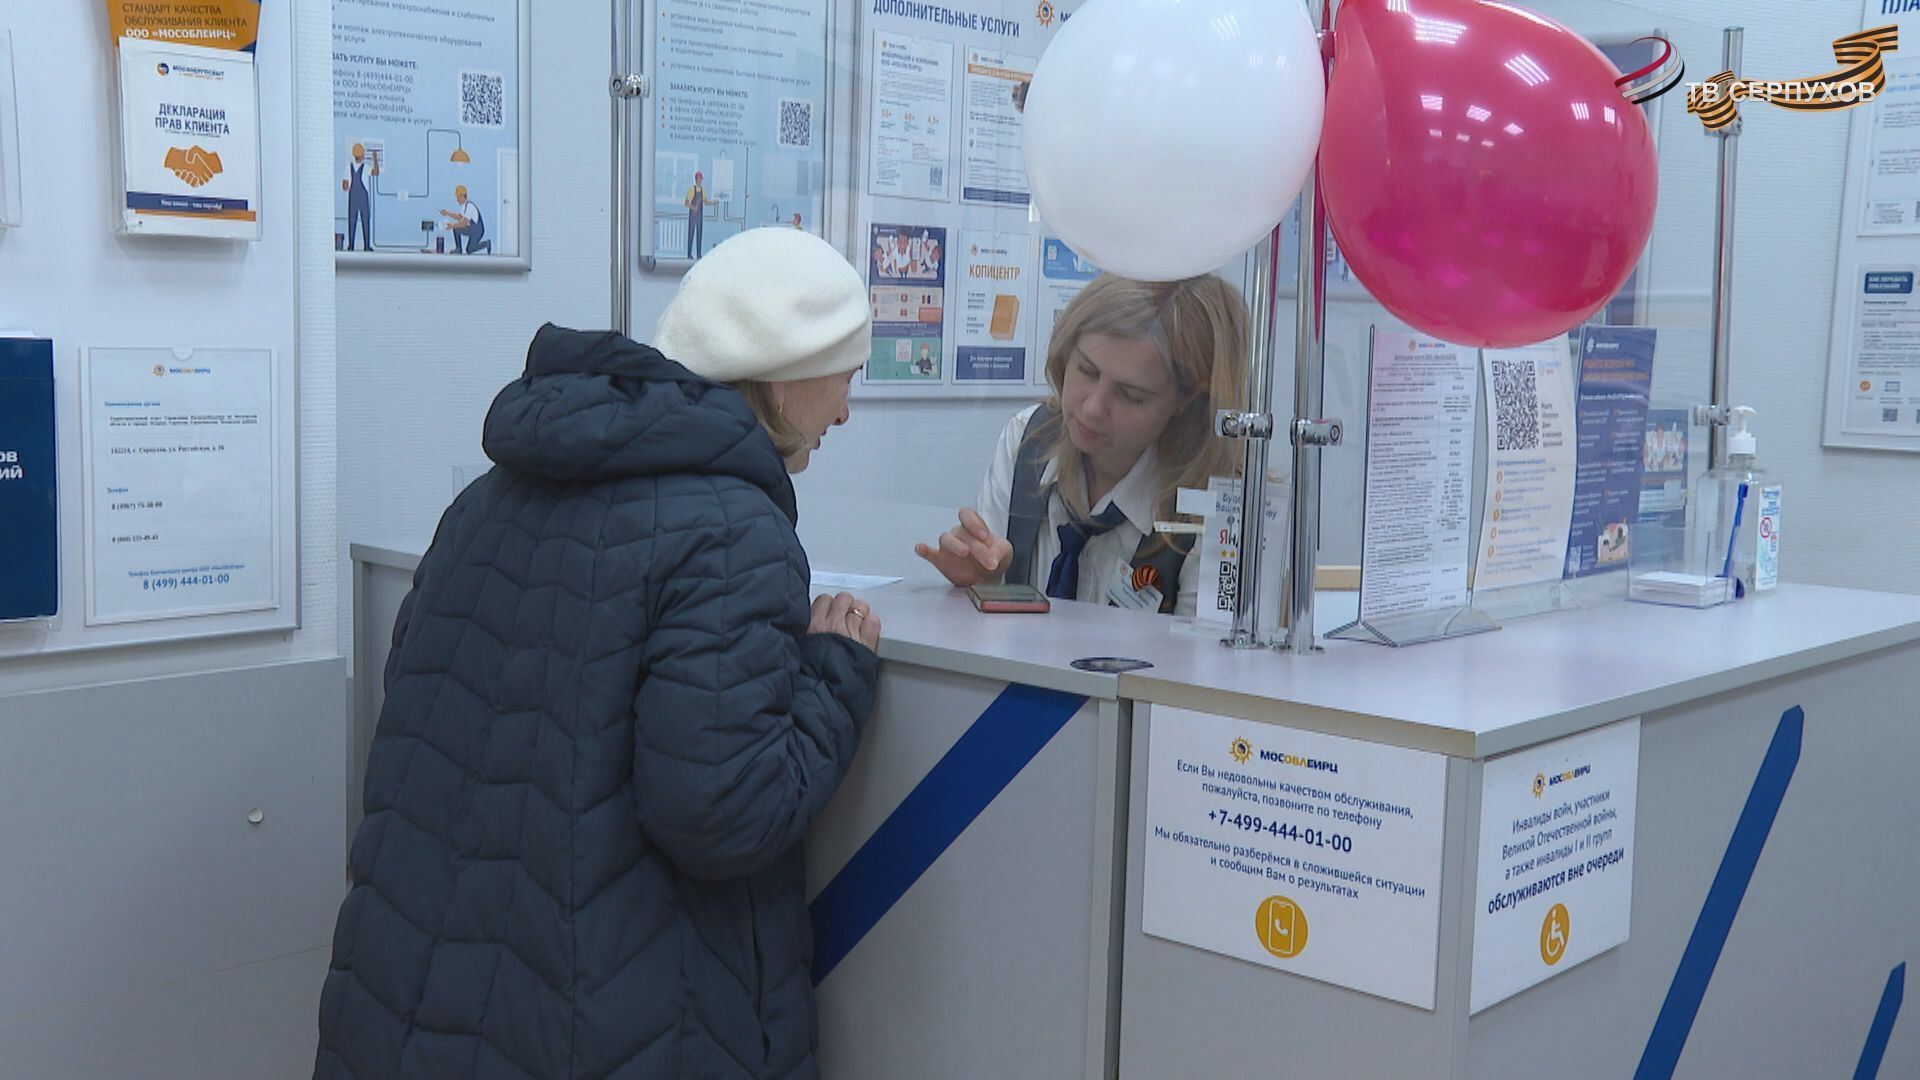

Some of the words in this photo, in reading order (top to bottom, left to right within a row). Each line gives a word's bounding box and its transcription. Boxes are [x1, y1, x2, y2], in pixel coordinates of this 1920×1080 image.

[122, 3, 171, 14] СТАНДАРТ
[174, 4, 222, 14] КАЧЕСТВА
[124, 15, 204, 26] ОБСЛУЖИВАНИЯ
[205, 17, 248, 27] КЛИЕНТА
[873, 0, 978, 30] ДОПОЛНИТЕЛЬНЫЕ
[981, 17, 1020, 38] УСЛУГИ
[126, 28, 149, 38] ООО
[349, 54, 374, 64] УСЛУГУ
[376, 57, 386, 66] ВЫ
[342, 79, 358, 88] ООО
[159, 103, 226, 121] ДЕКЛАРАЦИЯ
[344, 100, 360, 108] ООО
[155, 117, 182, 130] ПРАВ
[184, 120, 230, 135] КЛИЕНТА
[969, 263, 1020, 281] КОПИЦЕНТР
[143, 579, 149, 590] 8
[152, 578, 177, 591] (499)
[180, 573, 230, 586] 444-01-00
[1260, 749, 1339, 774] МОСОБЛЕИРЦ
[1177, 759, 1199, 774] Если
[1201, 765, 1215, 777] Вы
[1217, 769, 1277, 790] недовольны
[1279, 781, 1331, 801] качеством
[1334, 792, 1414, 819] обслуживания,
[1202, 783, 1260, 804] пожалуйста,
[1262, 794, 1314, 814] позвоните
[1317, 806, 1330, 817] по
[1332, 808, 1382, 830] телефону
[1512, 811, 1552, 835] Инвалиды
[1553, 803, 1573, 821] войн,
[1574, 790, 1611, 817] участники
[1208, 809, 1352, 853] +7-499-444-01-00
[1502, 834, 1536, 861] Великой
[1537, 815, 1592, 846] Отечественной
[1593, 808, 1617, 826] войны,
[1155, 826, 1170, 839] Мы
[1173, 832, 1231, 853] обязательно
[1233, 845, 1291, 867] разберёмся
[1294, 858, 1300, 868] в
[1302, 861, 1373, 885] сложившейся
[1375, 878, 1425, 898] ситуации
[1505, 868, 1510, 880] а
[1512, 857, 1535, 876] также
[1536, 845, 1573, 868] инвалиды
[1592, 829, 1612, 848] групп
[1210, 857, 1217, 866] и
[1219, 858, 1263, 877] сообщим
[1266, 867, 1286, 882] Вам
[1288, 875, 1295, 884] о
[1298, 875, 1360, 900] результатах
[1488, 871, 1566, 915] обслуживаются
[1567, 863, 1585, 881] вне
[1586, 848, 1625, 873] очереди
